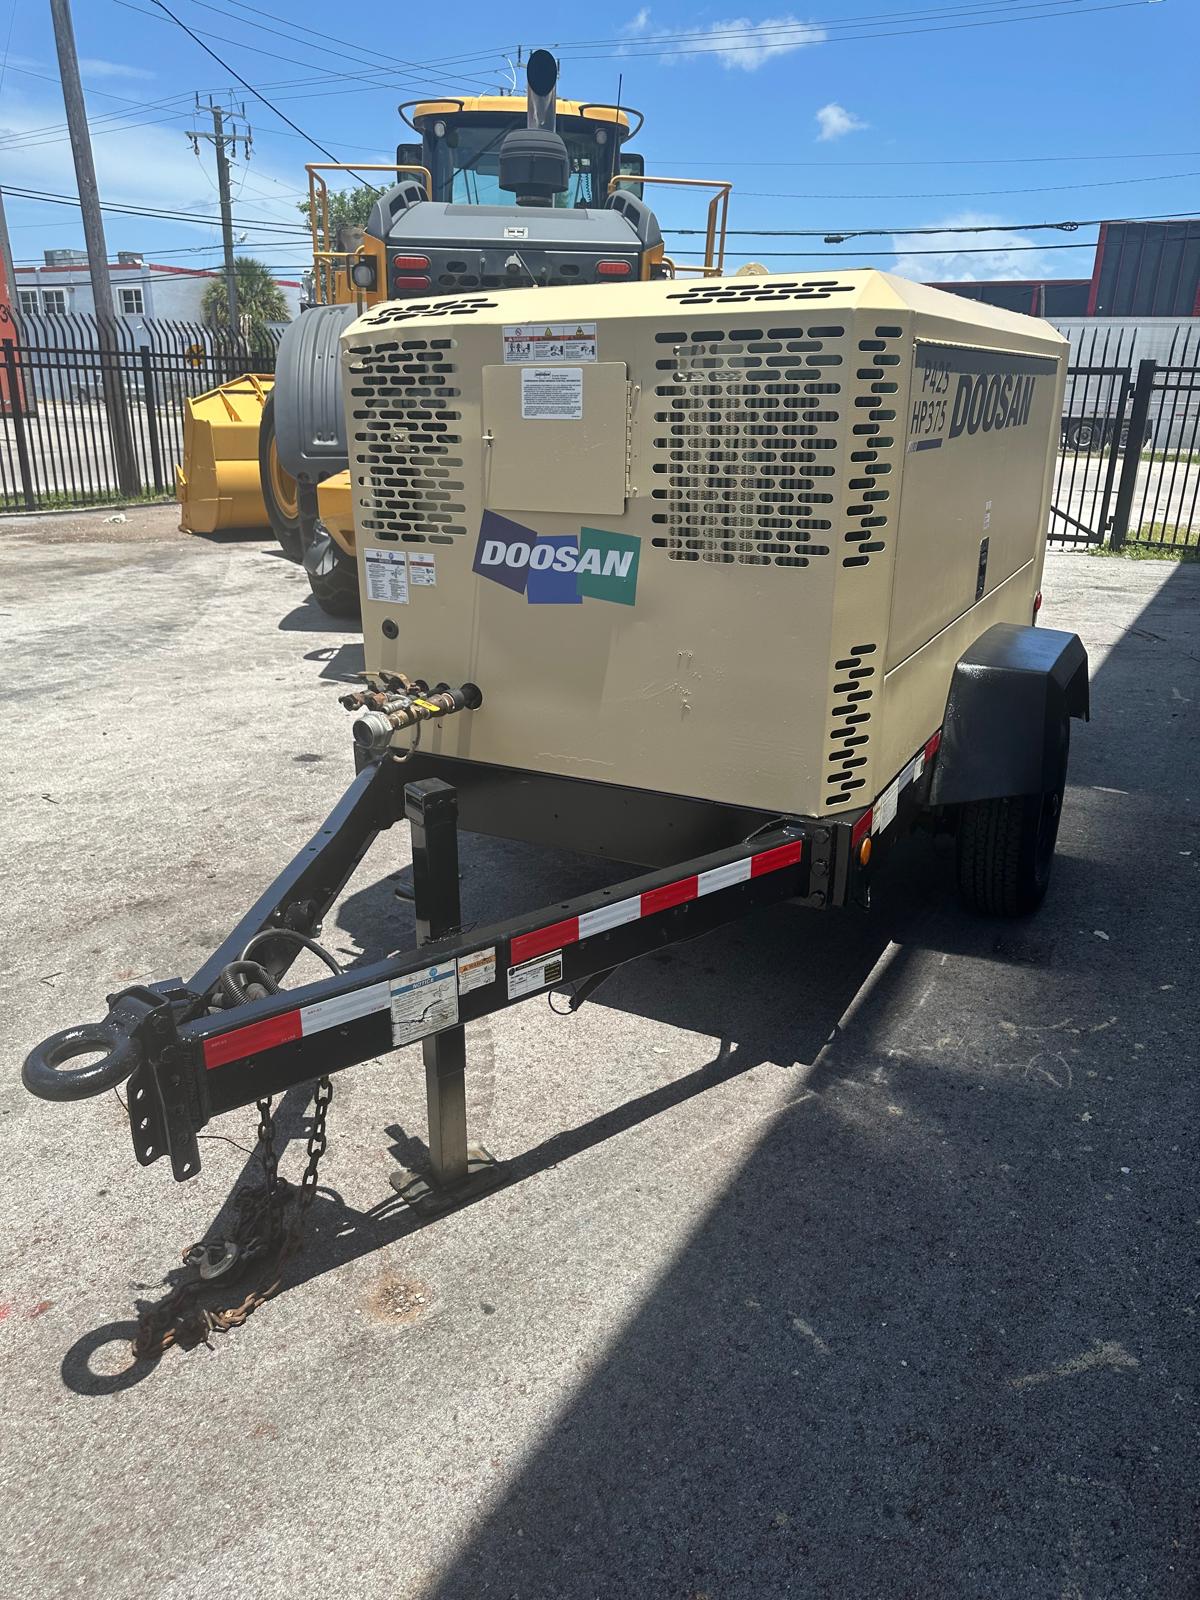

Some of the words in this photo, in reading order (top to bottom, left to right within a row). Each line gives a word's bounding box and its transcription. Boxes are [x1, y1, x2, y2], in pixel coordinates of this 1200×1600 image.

[922, 360, 951, 394] P425
[910, 400, 947, 434] HP375
[948, 373, 1036, 439] DOOSAN
[480, 540, 634, 577] DOOSAN
[412, 977, 434, 989] NOTICE
